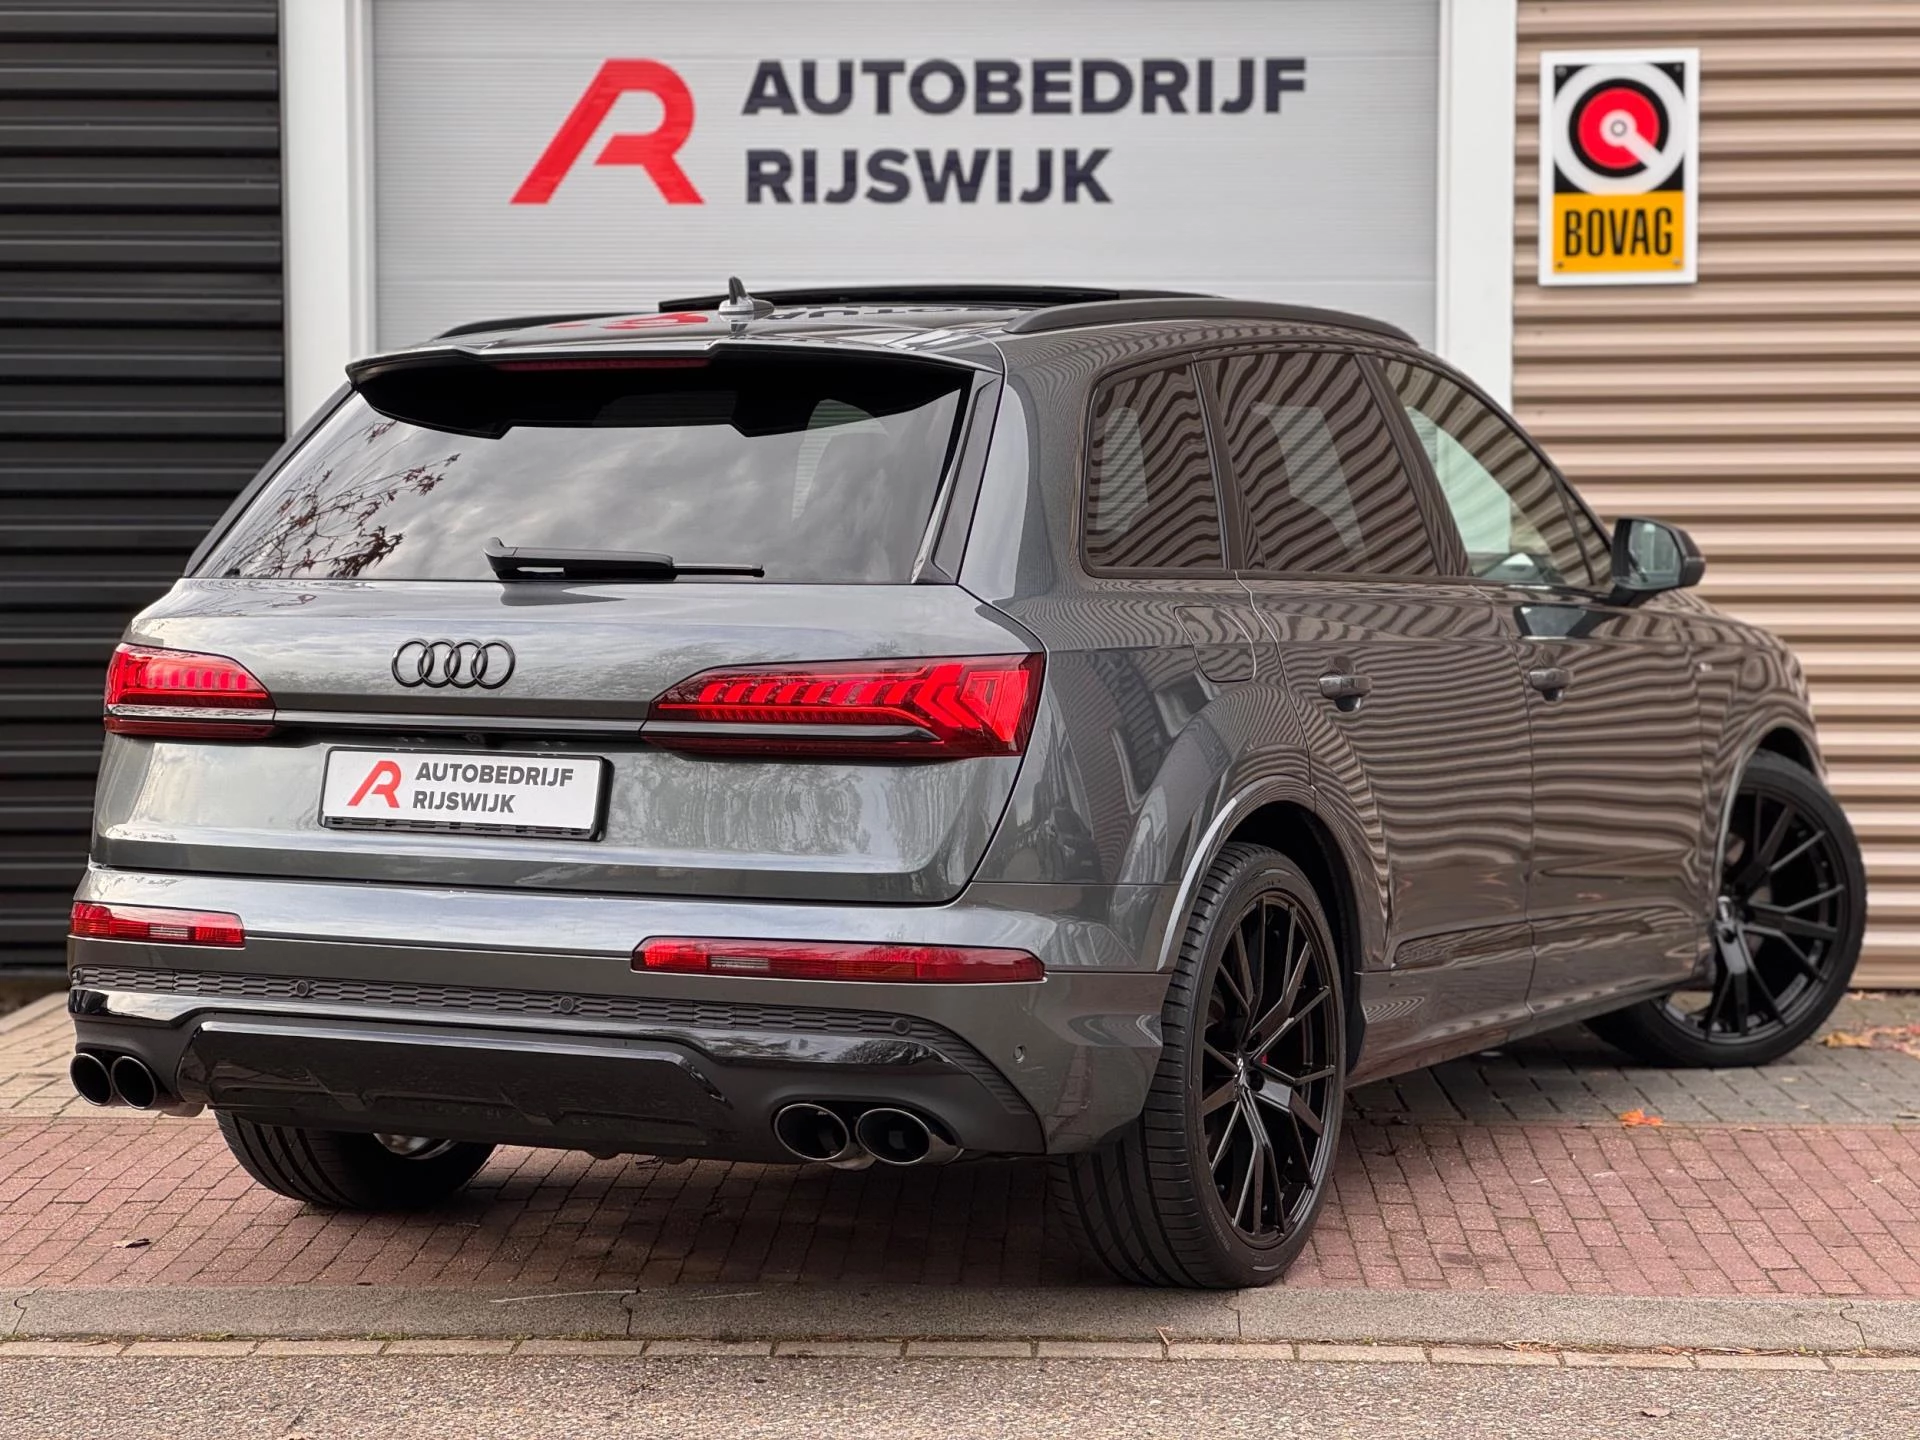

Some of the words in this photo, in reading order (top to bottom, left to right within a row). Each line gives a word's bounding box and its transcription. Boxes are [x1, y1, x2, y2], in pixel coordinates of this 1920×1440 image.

[742, 57, 1307, 116] AUTOBEDRIJF
[746, 148, 1112, 205] RIJSWIJK
[1564, 207, 1673, 258] BOVAG
[415, 762, 574, 787] AUTOBEDRIJF
[412, 790, 516, 814] RIJSWIJK
